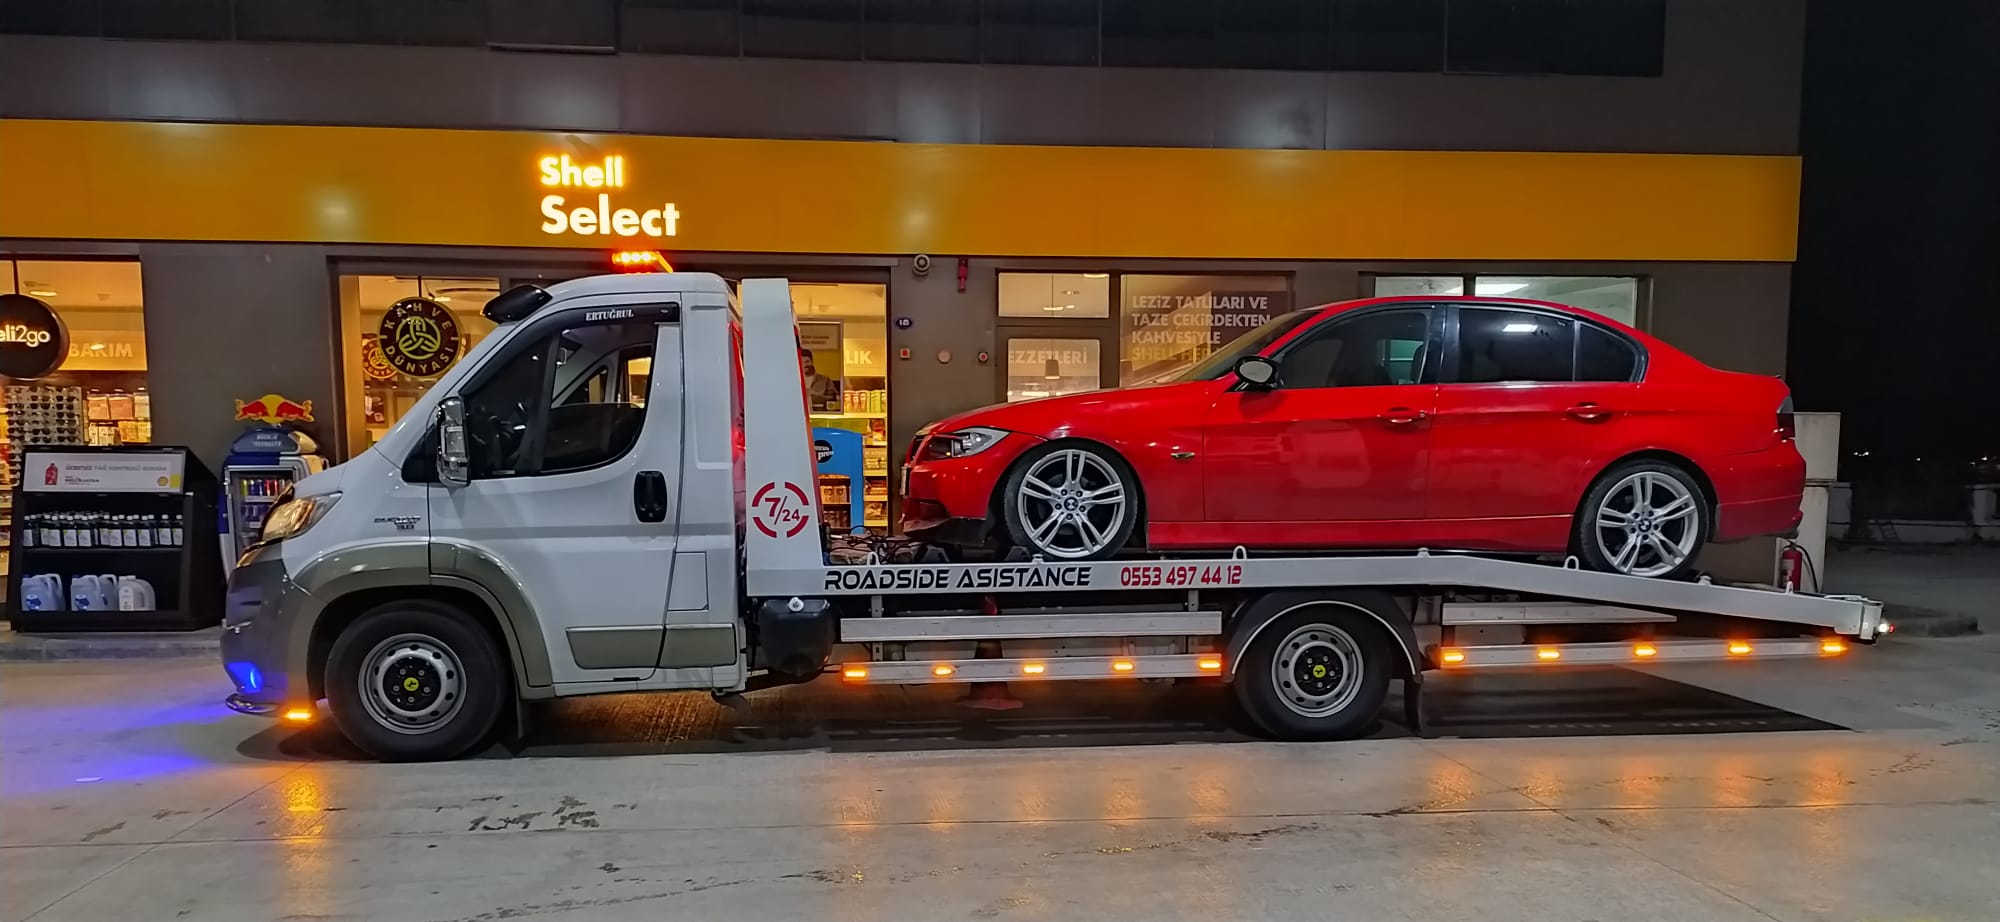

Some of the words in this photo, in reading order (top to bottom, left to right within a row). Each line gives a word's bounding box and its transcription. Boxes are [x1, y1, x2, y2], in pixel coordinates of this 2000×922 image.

[540, 154, 624, 187] Shell
[540, 194, 680, 237] Select
[585, 308, 634, 321] ERTUĞRUL
[1249, 296, 1268, 310] VE
[384, 303, 452, 330] KAHVE
[1132, 313, 1169, 326] TAZE
[385, 345, 454, 374] DÜNYASI
[824, 569, 950, 590] ROADSIDE
[956, 567, 1092, 588] ASISTANCE
[1120, 566, 1162, 587] 0553
[1166, 566, 1197, 585] 497
[1200, 566, 1222, 585] 44
[1227, 565, 1242, 585] 12
